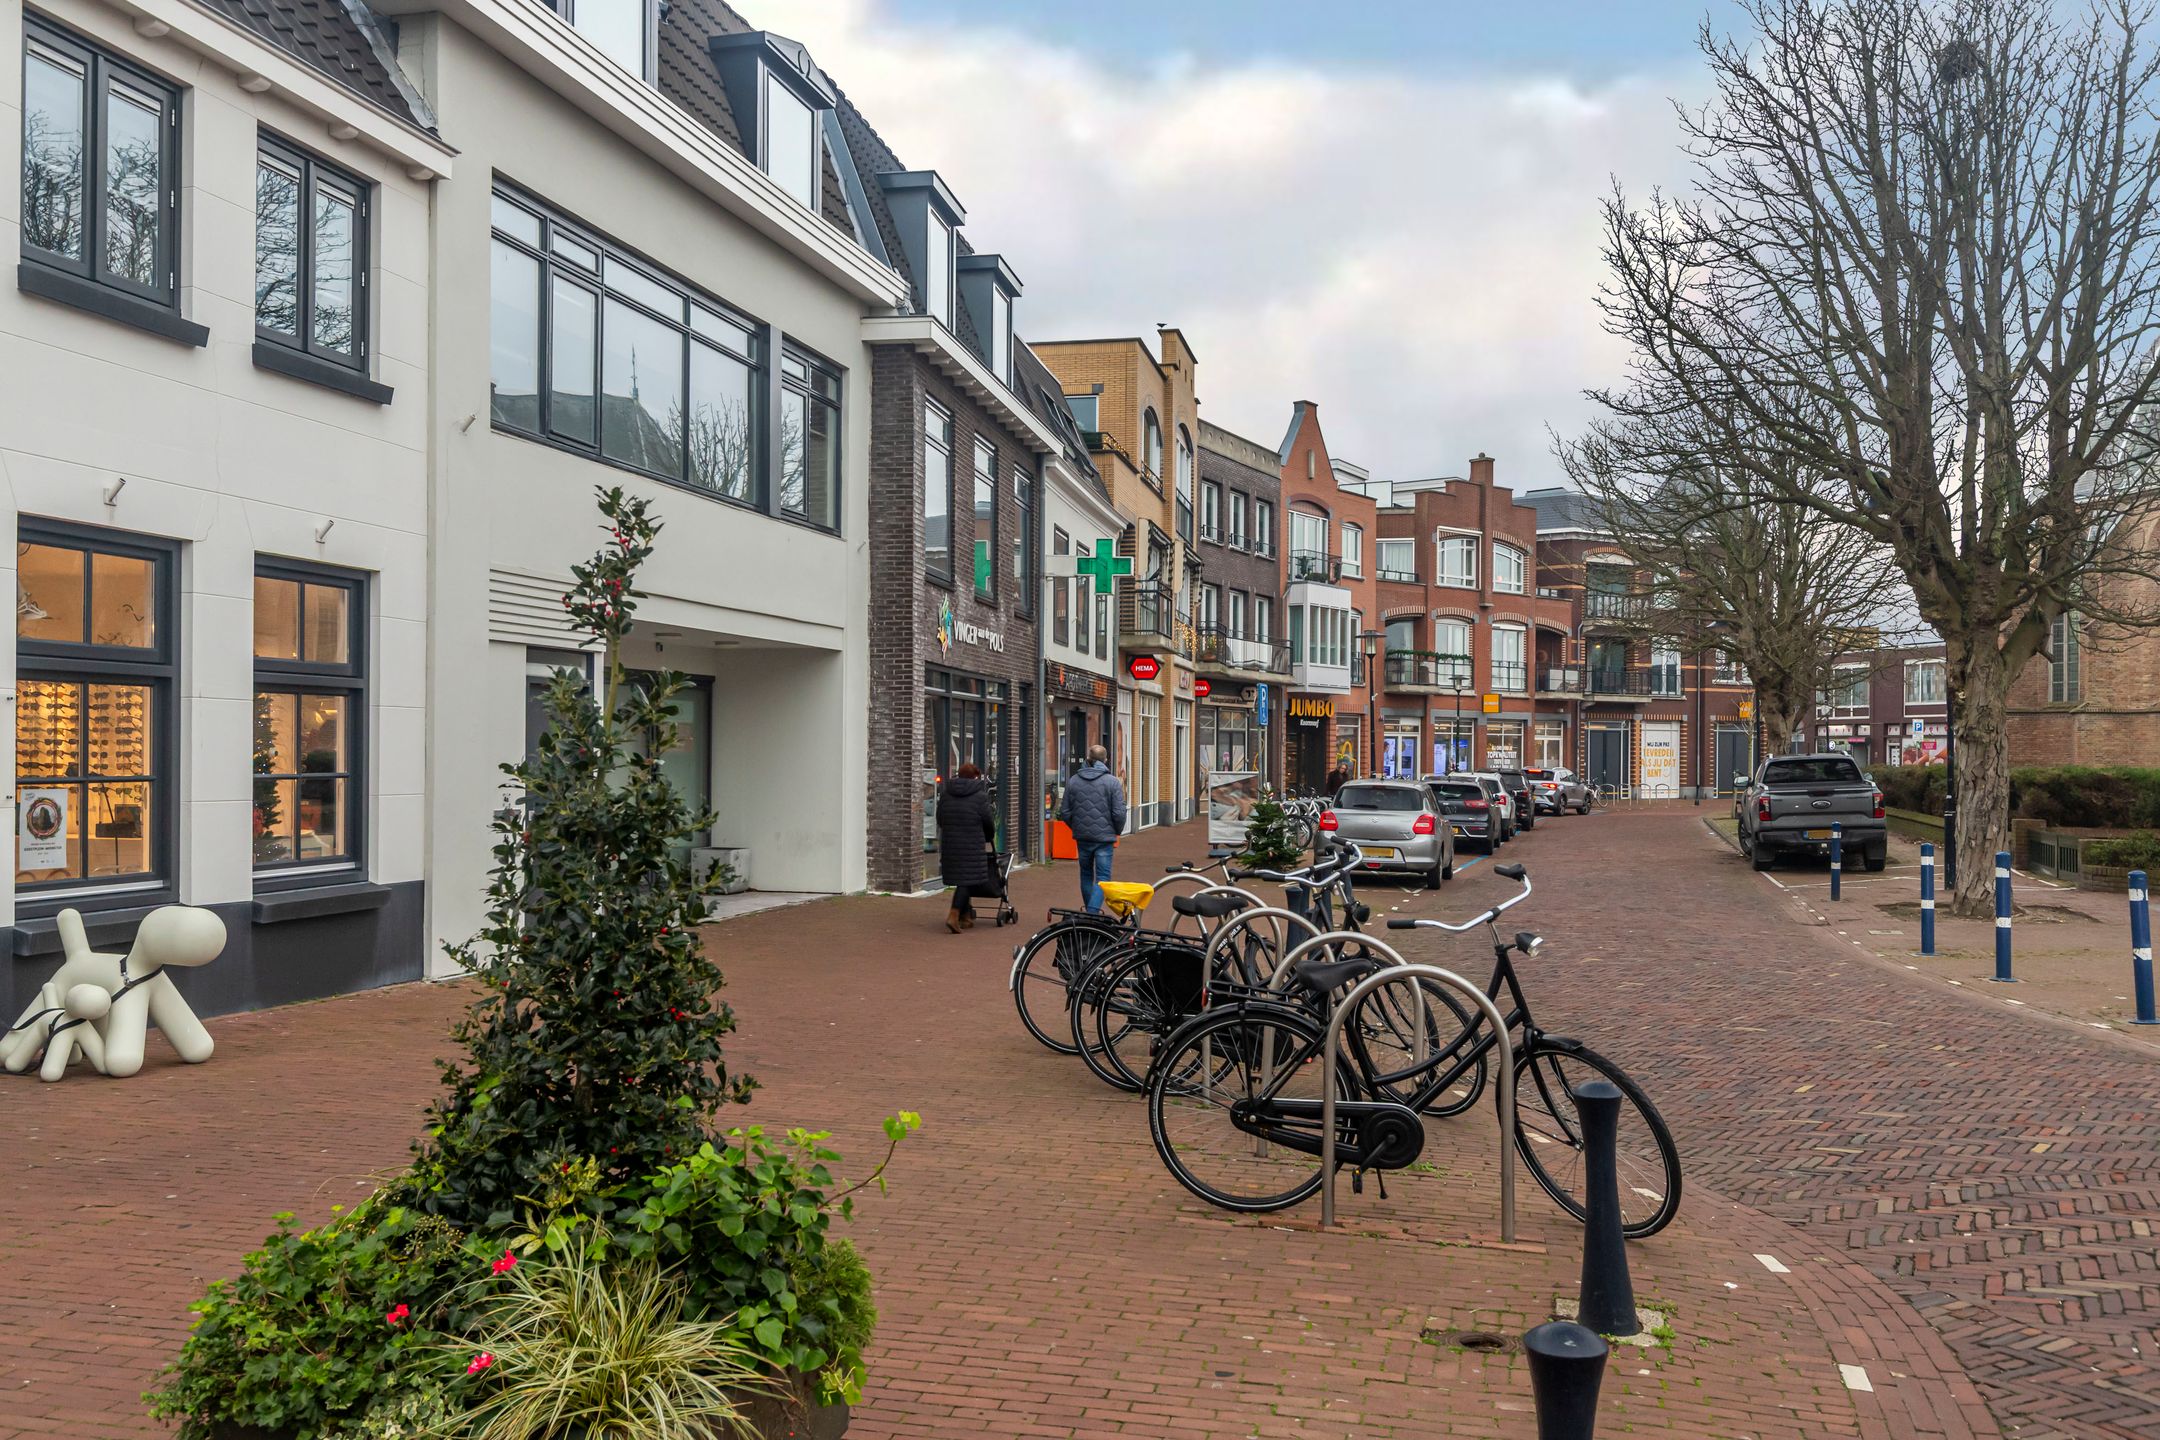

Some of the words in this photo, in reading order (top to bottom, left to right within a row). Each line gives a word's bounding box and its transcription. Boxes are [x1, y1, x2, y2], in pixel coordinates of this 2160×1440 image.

[954, 620, 977, 645] VINGER
[989, 631, 1004, 653] POLS
[1290, 698, 1335, 718] JUMBO
[1663, 758, 1676, 768] DAT
